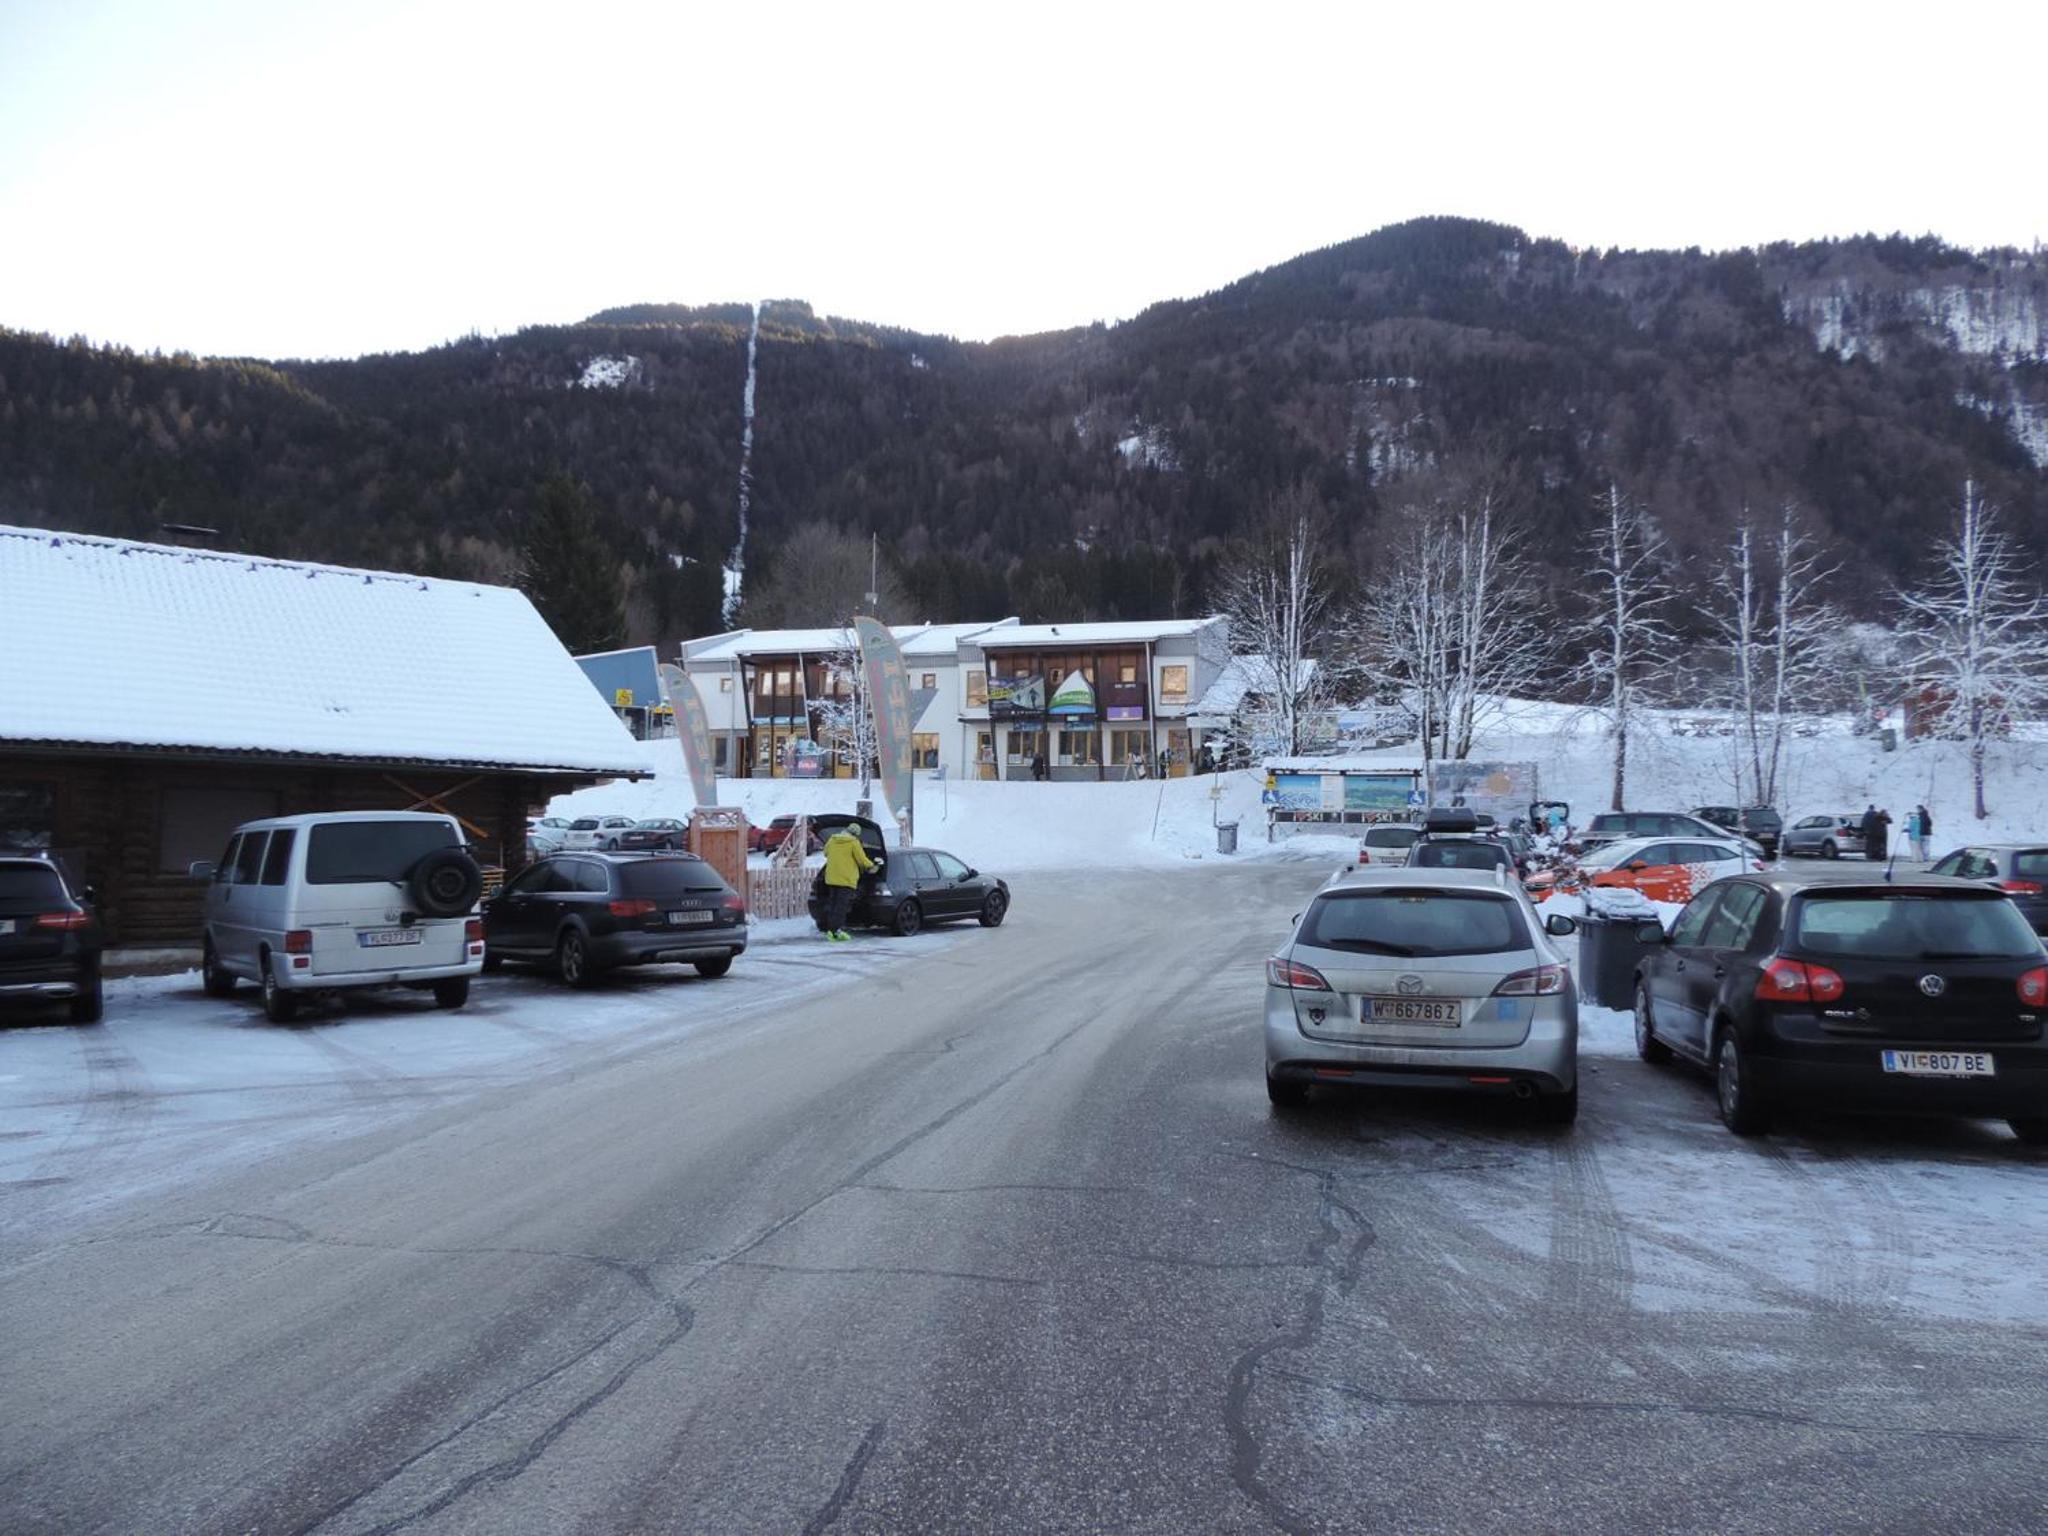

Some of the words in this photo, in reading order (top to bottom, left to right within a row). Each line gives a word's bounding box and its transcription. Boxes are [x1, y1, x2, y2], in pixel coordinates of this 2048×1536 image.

[1307, 811, 1323, 821] SKI
[1376, 812, 1392, 822] SKI
[1395, 1003, 1442, 1019] 66786
[1900, 1054, 1916, 1069] VI
[1929, 1054, 1960, 1070] 807
[1964, 1056, 1986, 1071] BE
